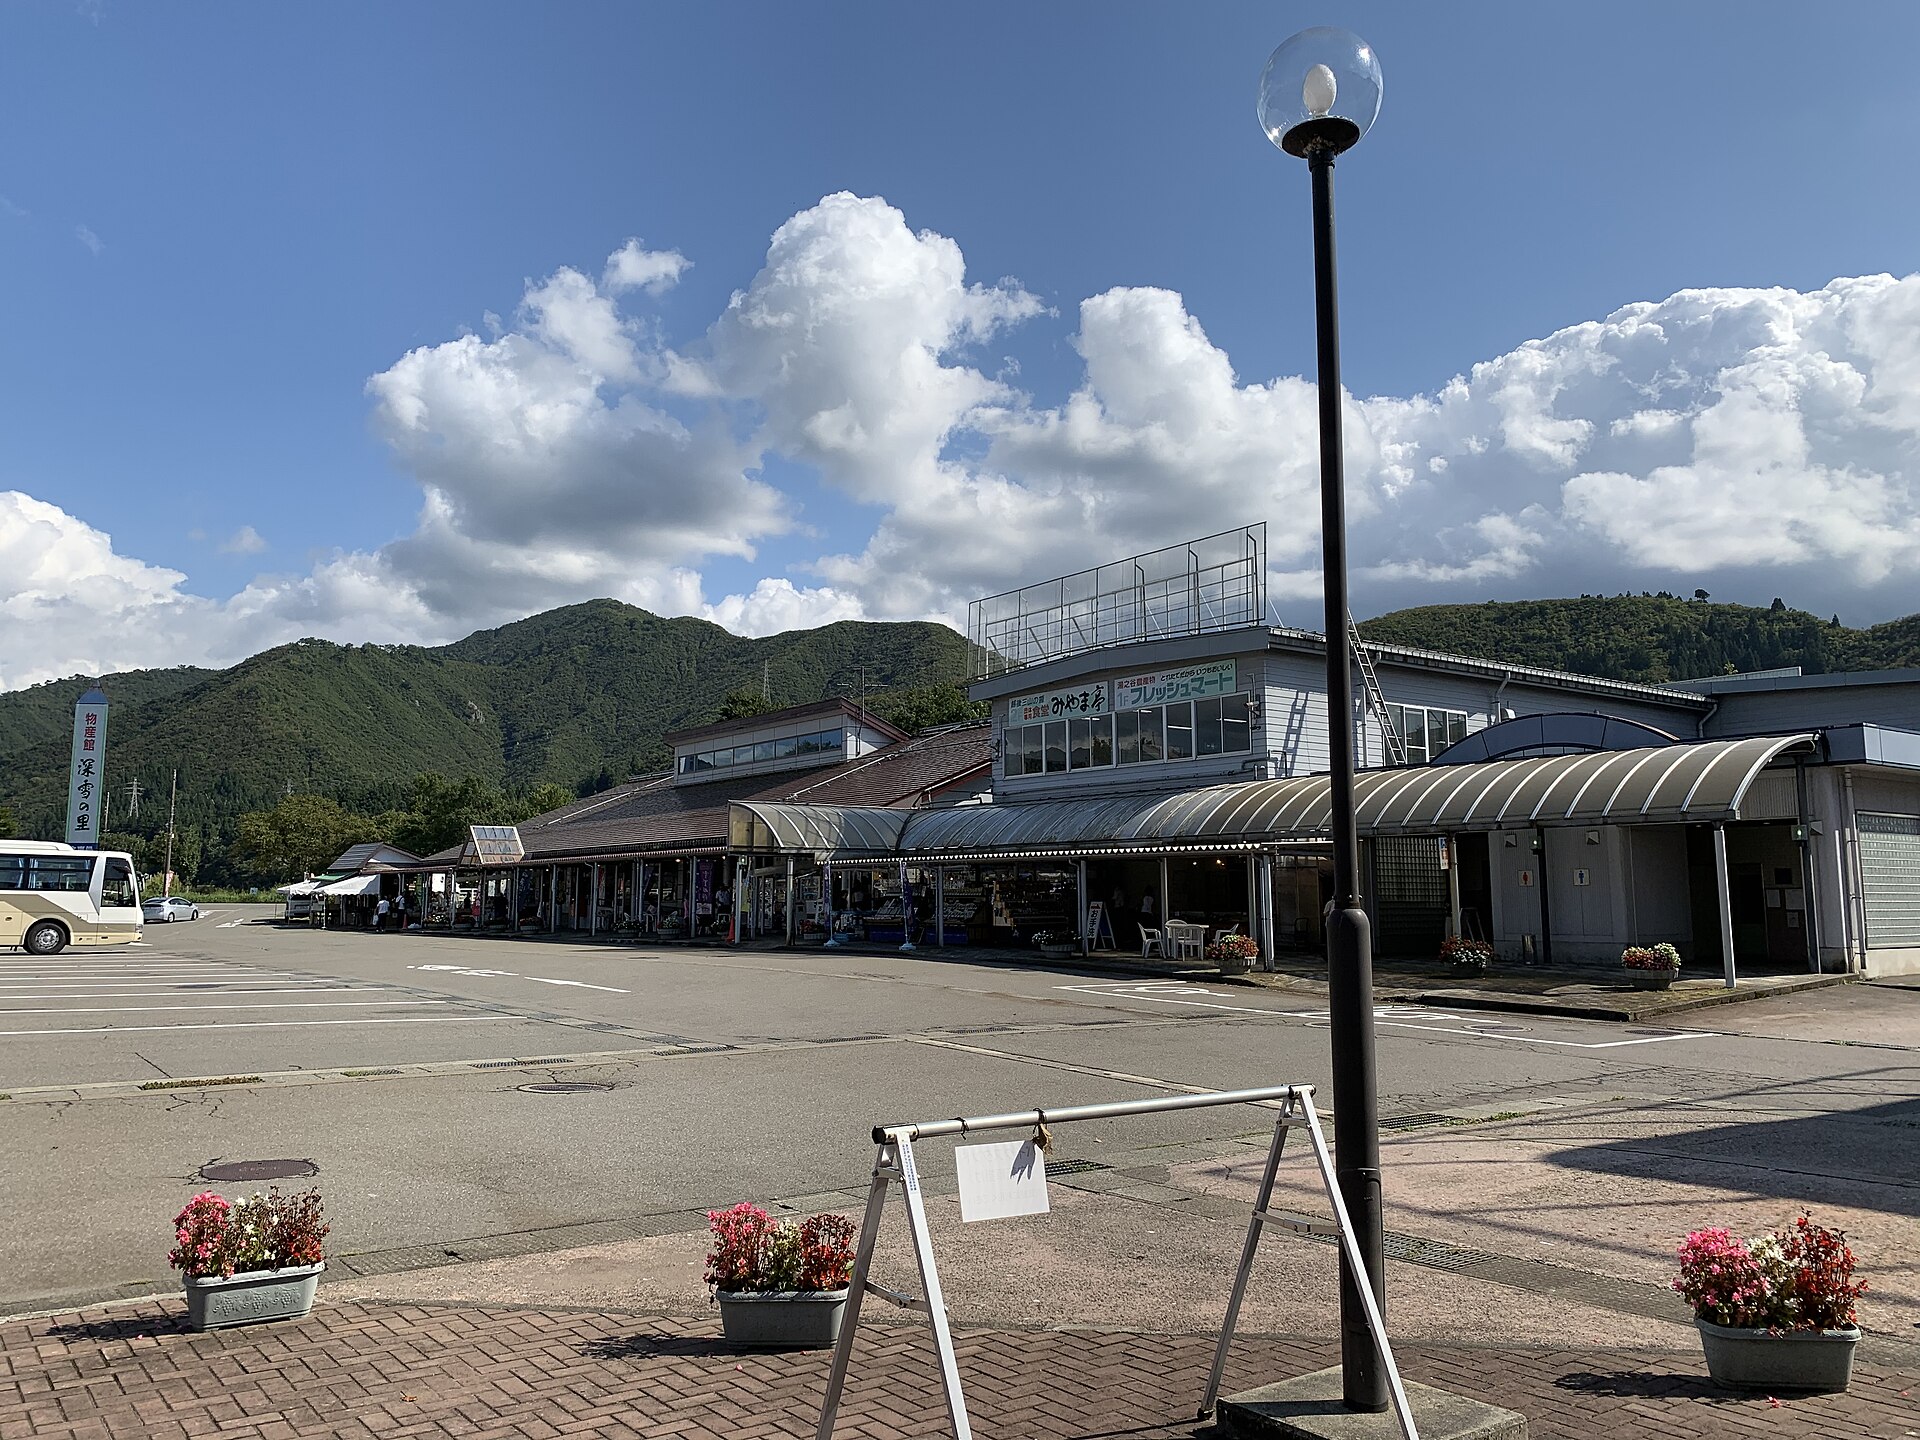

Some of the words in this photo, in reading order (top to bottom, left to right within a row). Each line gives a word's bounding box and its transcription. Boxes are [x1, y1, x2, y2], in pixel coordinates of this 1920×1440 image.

[1051, 684, 1106, 717] みやま亭
[1117, 692, 1129, 707] 1F
[1130, 673, 1233, 705] フレッシュマート
[1032, 704, 1050, 719] 食堂
[83, 713, 97, 751] 物産館
[75, 758, 96, 831] 深雪の里
